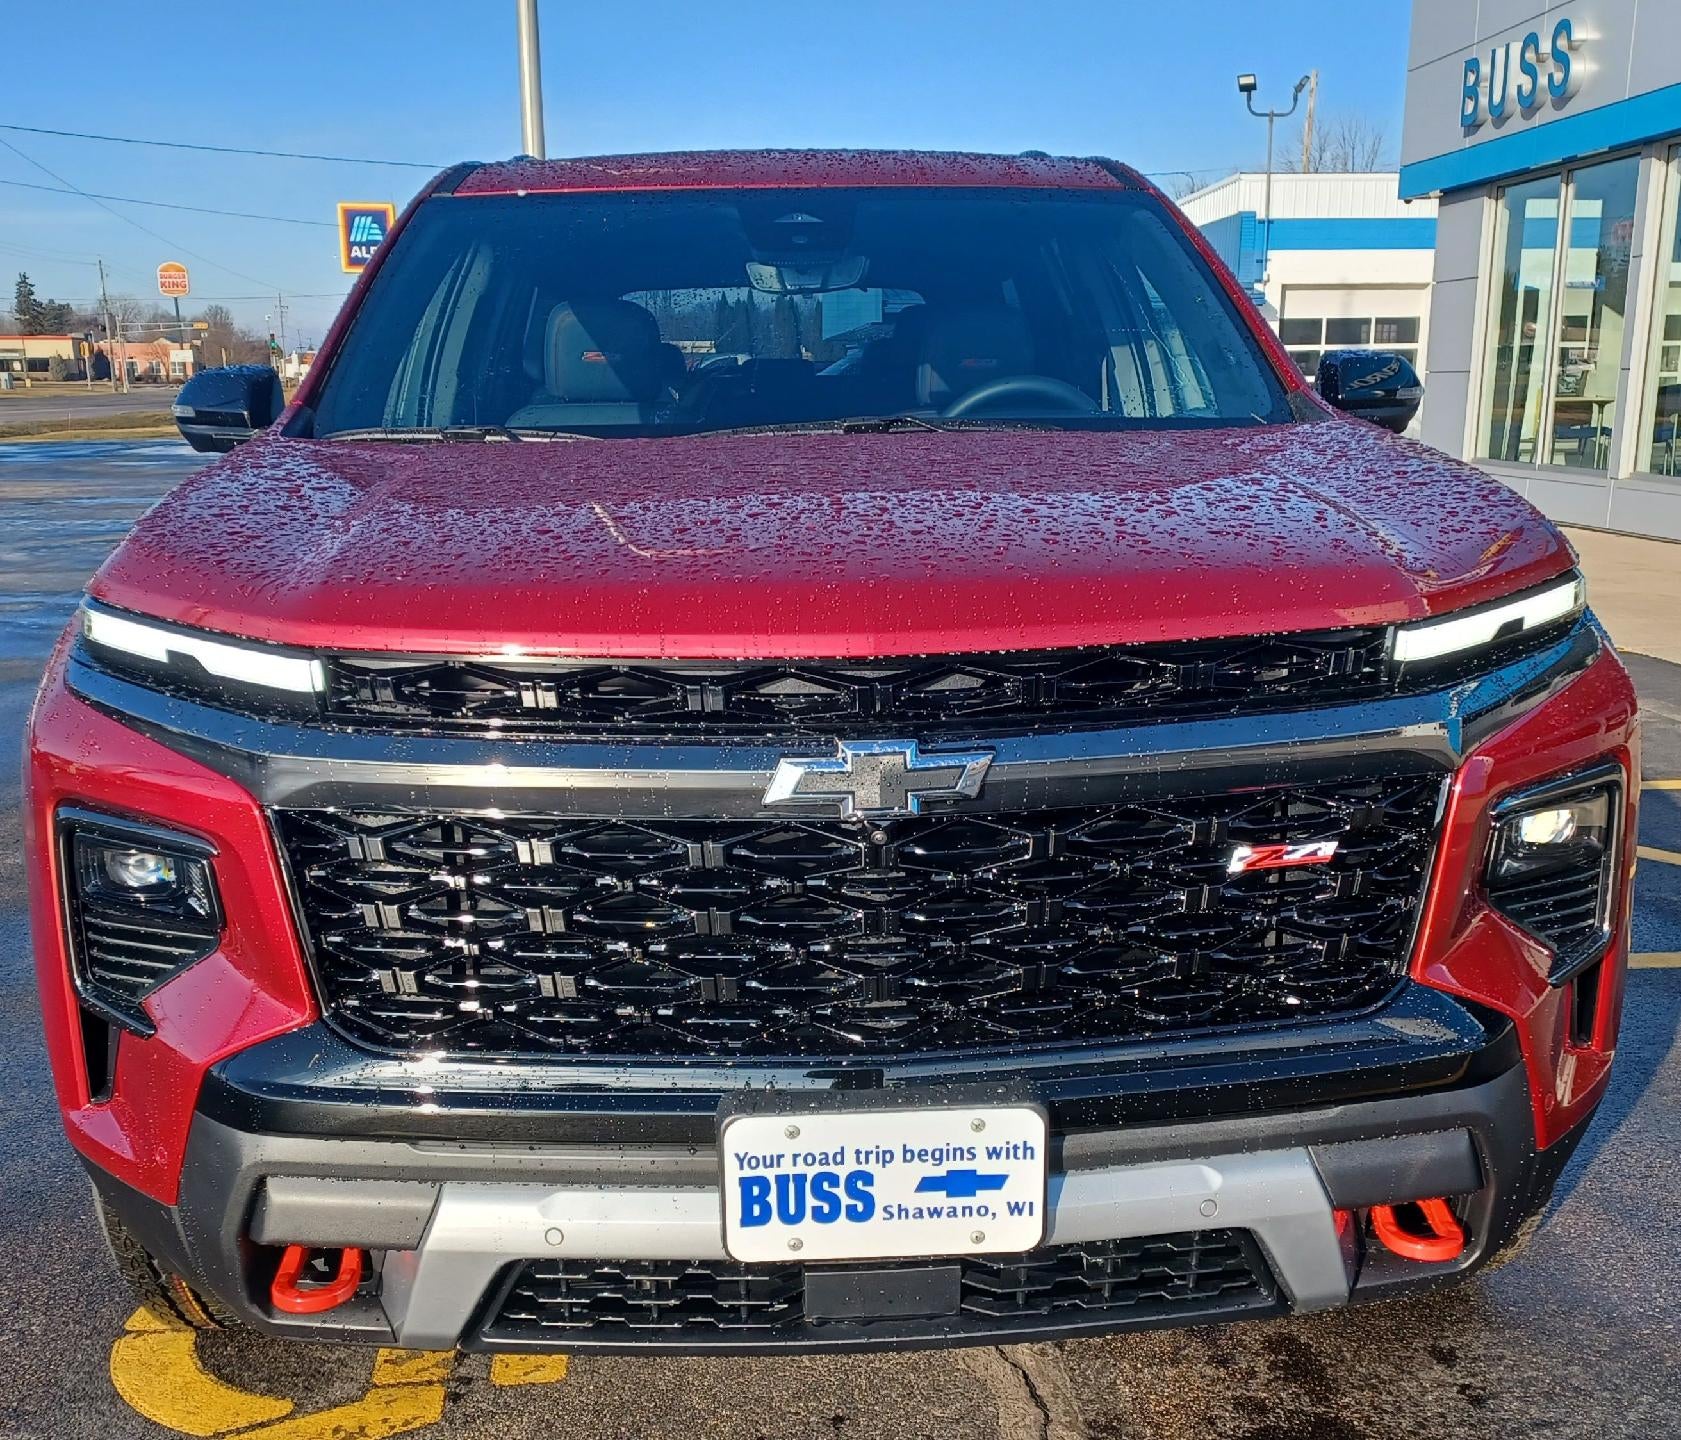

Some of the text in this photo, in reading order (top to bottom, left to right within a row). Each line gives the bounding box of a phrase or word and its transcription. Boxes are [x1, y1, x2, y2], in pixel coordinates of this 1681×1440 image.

[1460, 17, 1572, 128] BUSS
[160, 280, 187, 288] KING
[734, 1141, 1035, 1171] Your road trip begins with
[738, 1170, 876, 1228] BUSS
[882, 1201, 1034, 1221] Shawano, WI
